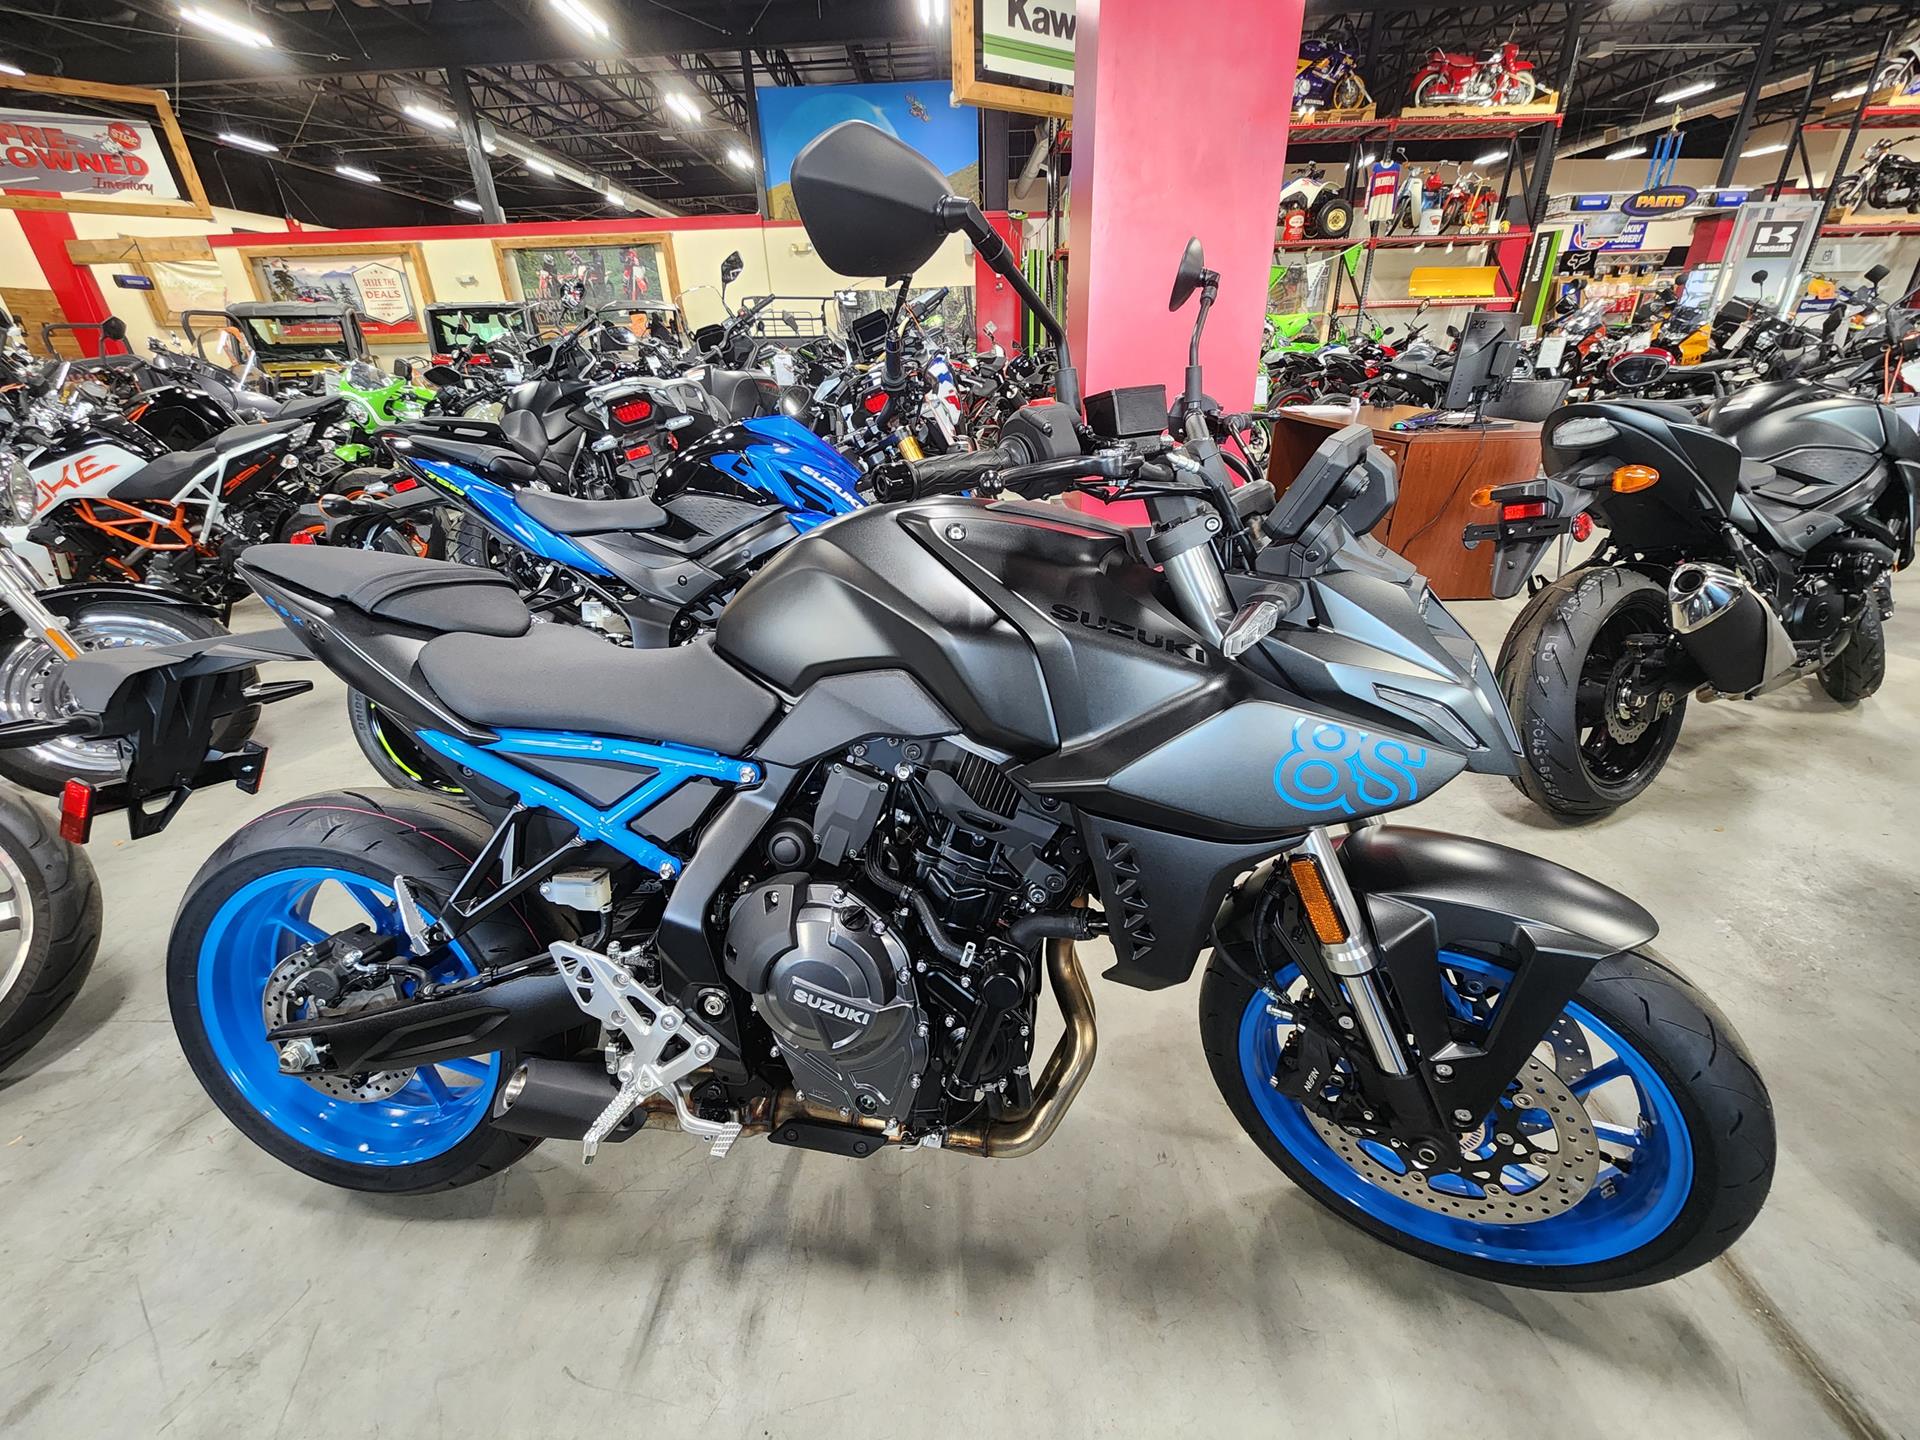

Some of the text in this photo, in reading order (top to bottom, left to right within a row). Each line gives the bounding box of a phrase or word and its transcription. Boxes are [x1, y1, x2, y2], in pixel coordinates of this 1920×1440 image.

[110, 128, 139, 145] STOP
[5, 146, 149, 177] OWNED
[92, 176, 154, 194] Inventory
[1635, 195, 1687, 208] PARTS
[1752, 244, 1792, 253] Kawasaki
[362, 278, 397, 287] SEIZE THE
[365, 290, 401, 299] DEALS
[1050, 603, 1206, 664] SUZUKI
[793, 988, 871, 1026] SUZUKI
